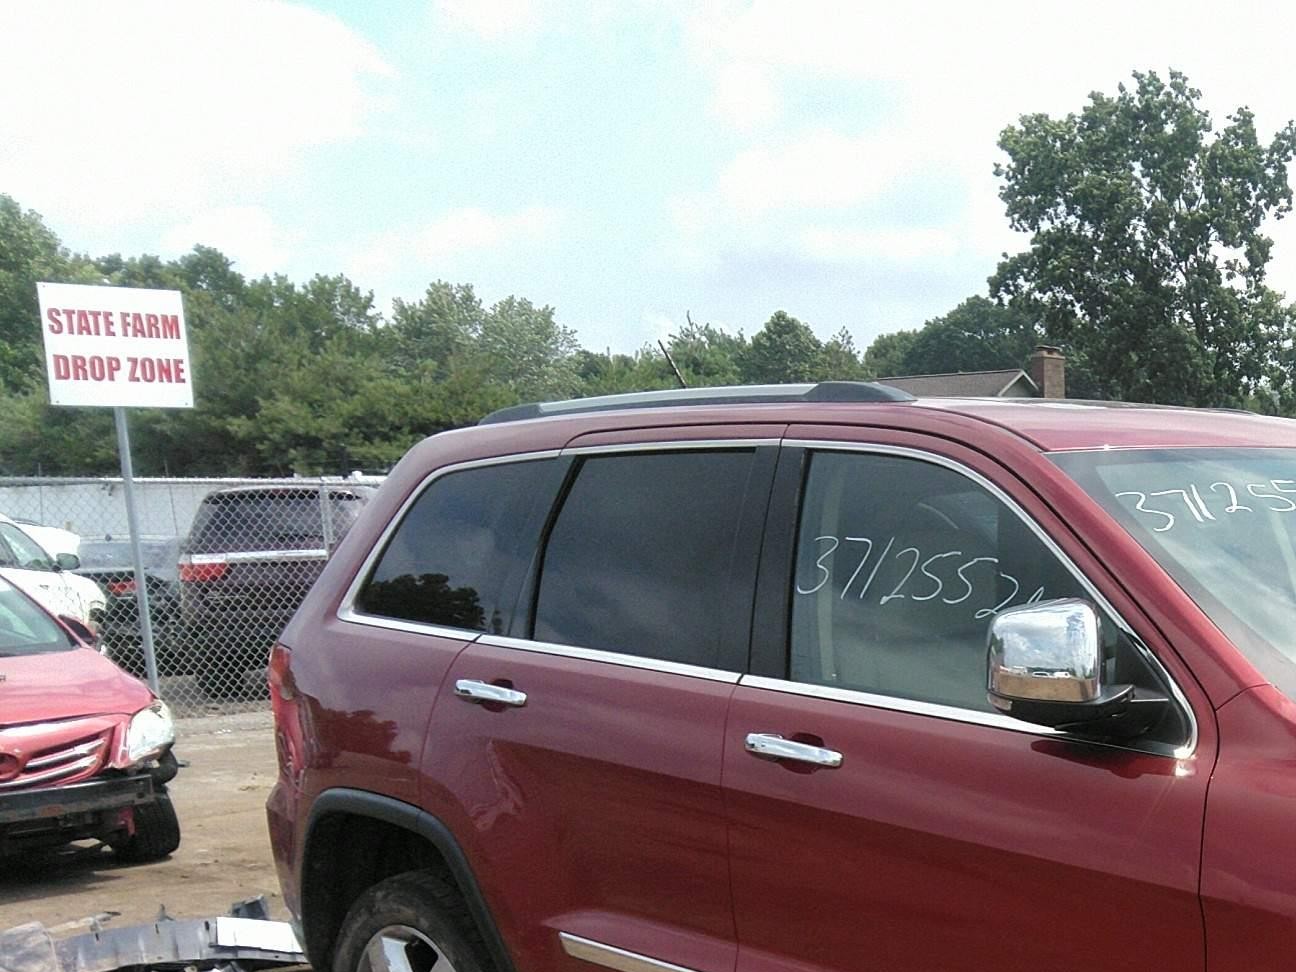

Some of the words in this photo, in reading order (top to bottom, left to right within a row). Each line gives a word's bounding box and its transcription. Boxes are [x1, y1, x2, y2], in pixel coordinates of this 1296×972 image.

[47, 307, 116, 337] STATE
[120, 311, 181, 340] FARM
[52, 354, 121, 382] DROP
[127, 357, 186, 384] ZONE
